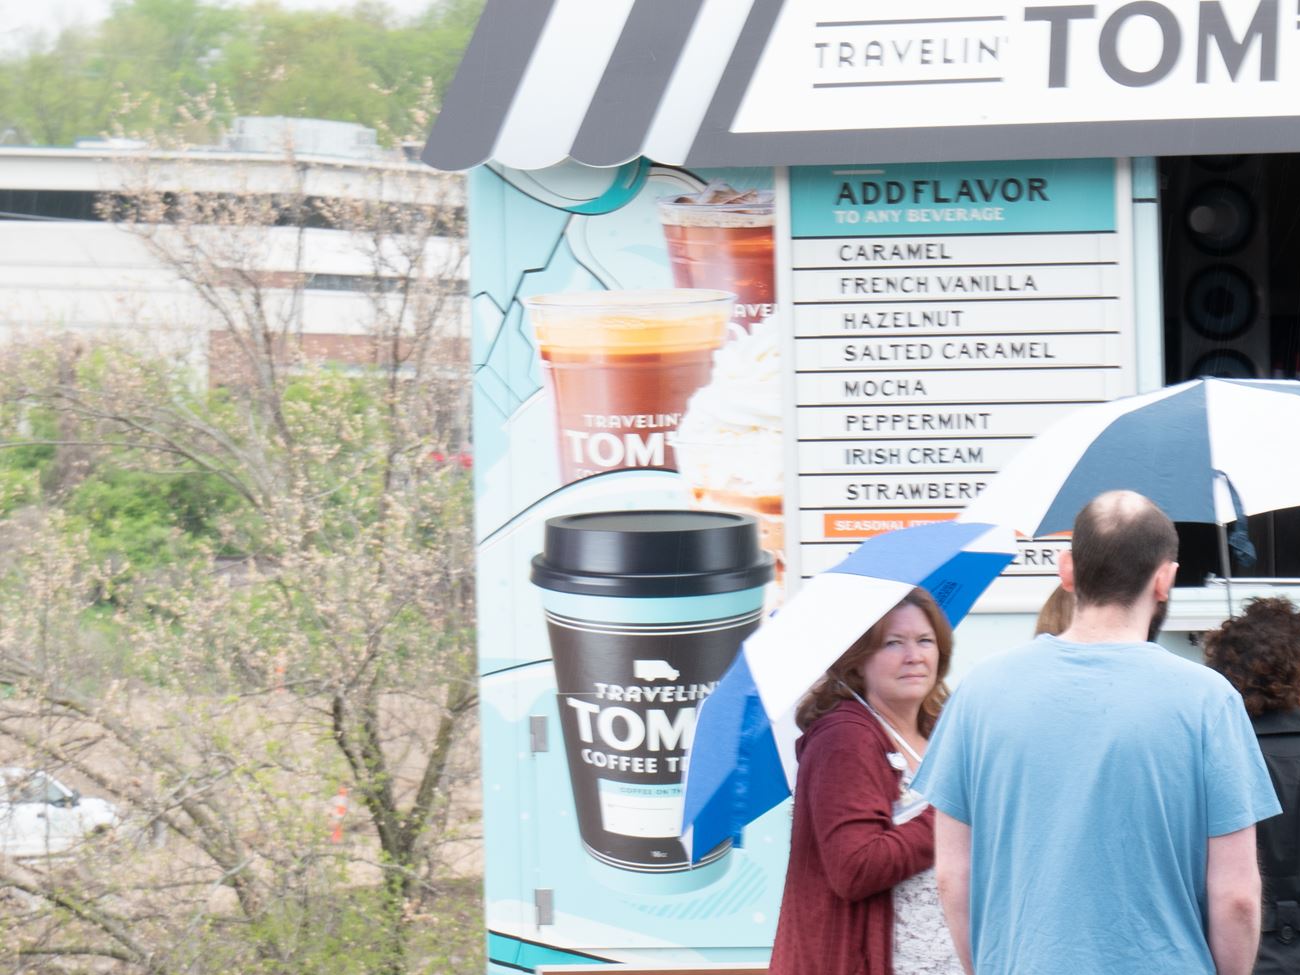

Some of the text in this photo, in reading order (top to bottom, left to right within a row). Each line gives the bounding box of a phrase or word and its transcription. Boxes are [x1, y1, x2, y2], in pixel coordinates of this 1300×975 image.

[834, 177, 1050, 206] ADD FLAVOR
[835, 207, 1005, 224] TO ANY BEVERAGE
[838, 243, 953, 262] CARAMEL
[840, 275, 1039, 295] FRENCH VANILLA
[843, 310, 965, 329] HAZELNUT
[844, 342, 1056, 362] SALTED CARAMEL
[844, 379, 927, 397] MOCHA
[846, 413, 993, 432] PEPPERMINT
[845, 447, 984, 466] IRISH CREAM
[566, 697, 698, 752] TOM
[581, 748, 659, 774] COFFEE
